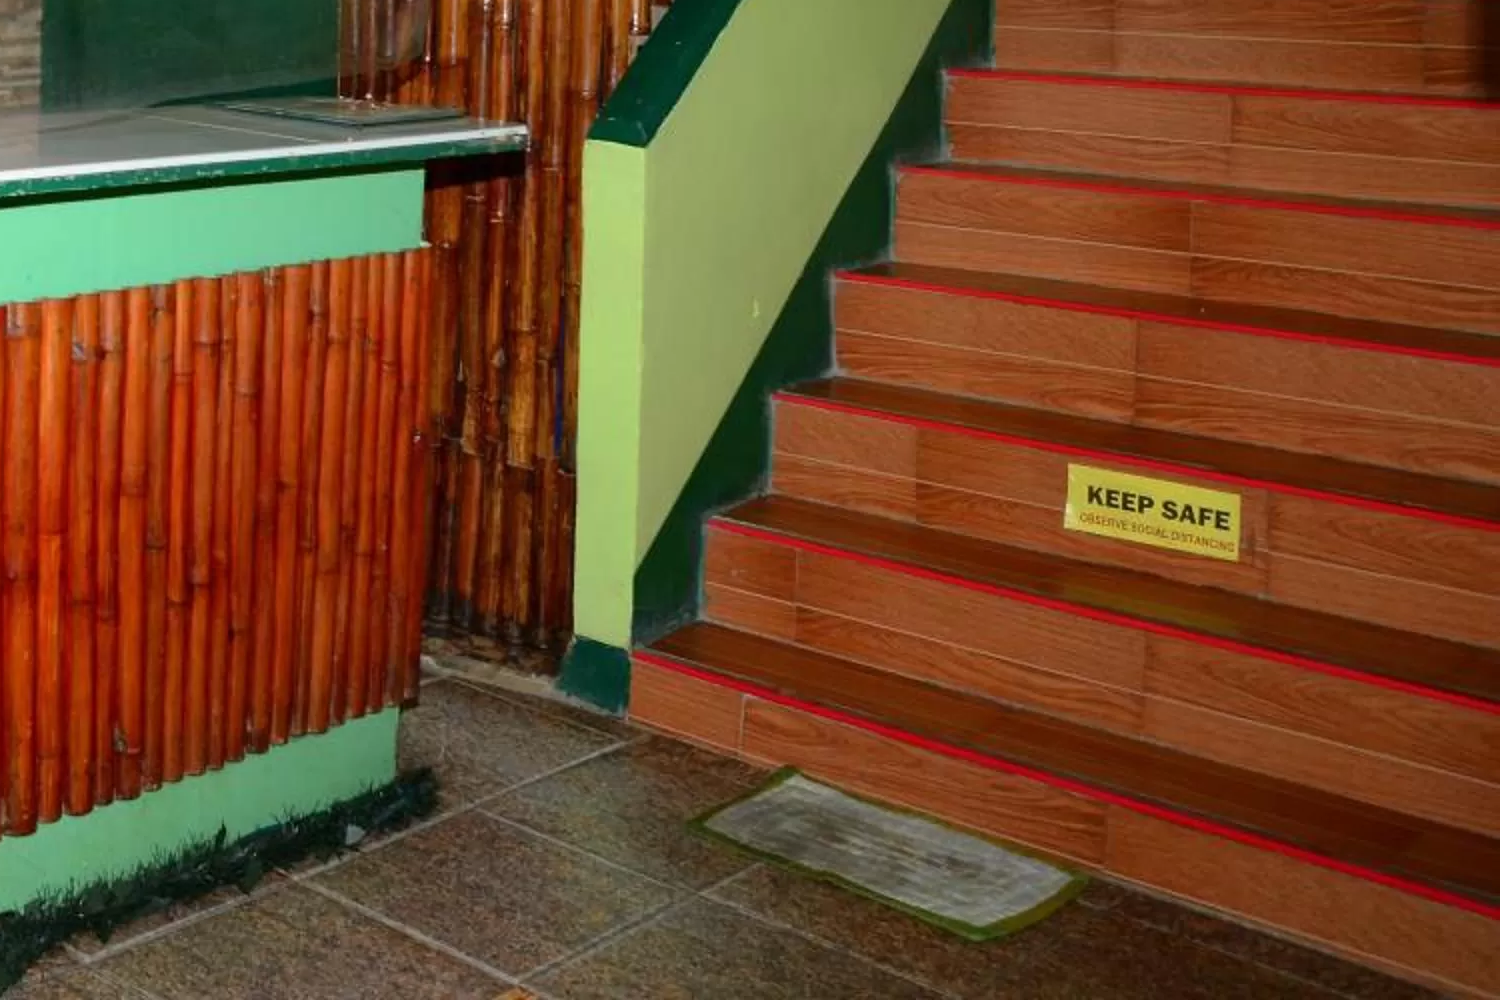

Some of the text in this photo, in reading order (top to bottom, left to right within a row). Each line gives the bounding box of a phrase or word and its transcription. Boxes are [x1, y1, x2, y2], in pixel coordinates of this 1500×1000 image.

[1079, 511, 1128, 532] OBSERVE
[1131, 522, 1169, 539] SOCIAL
[1087, 485, 1231, 531] KEEP SAFE
